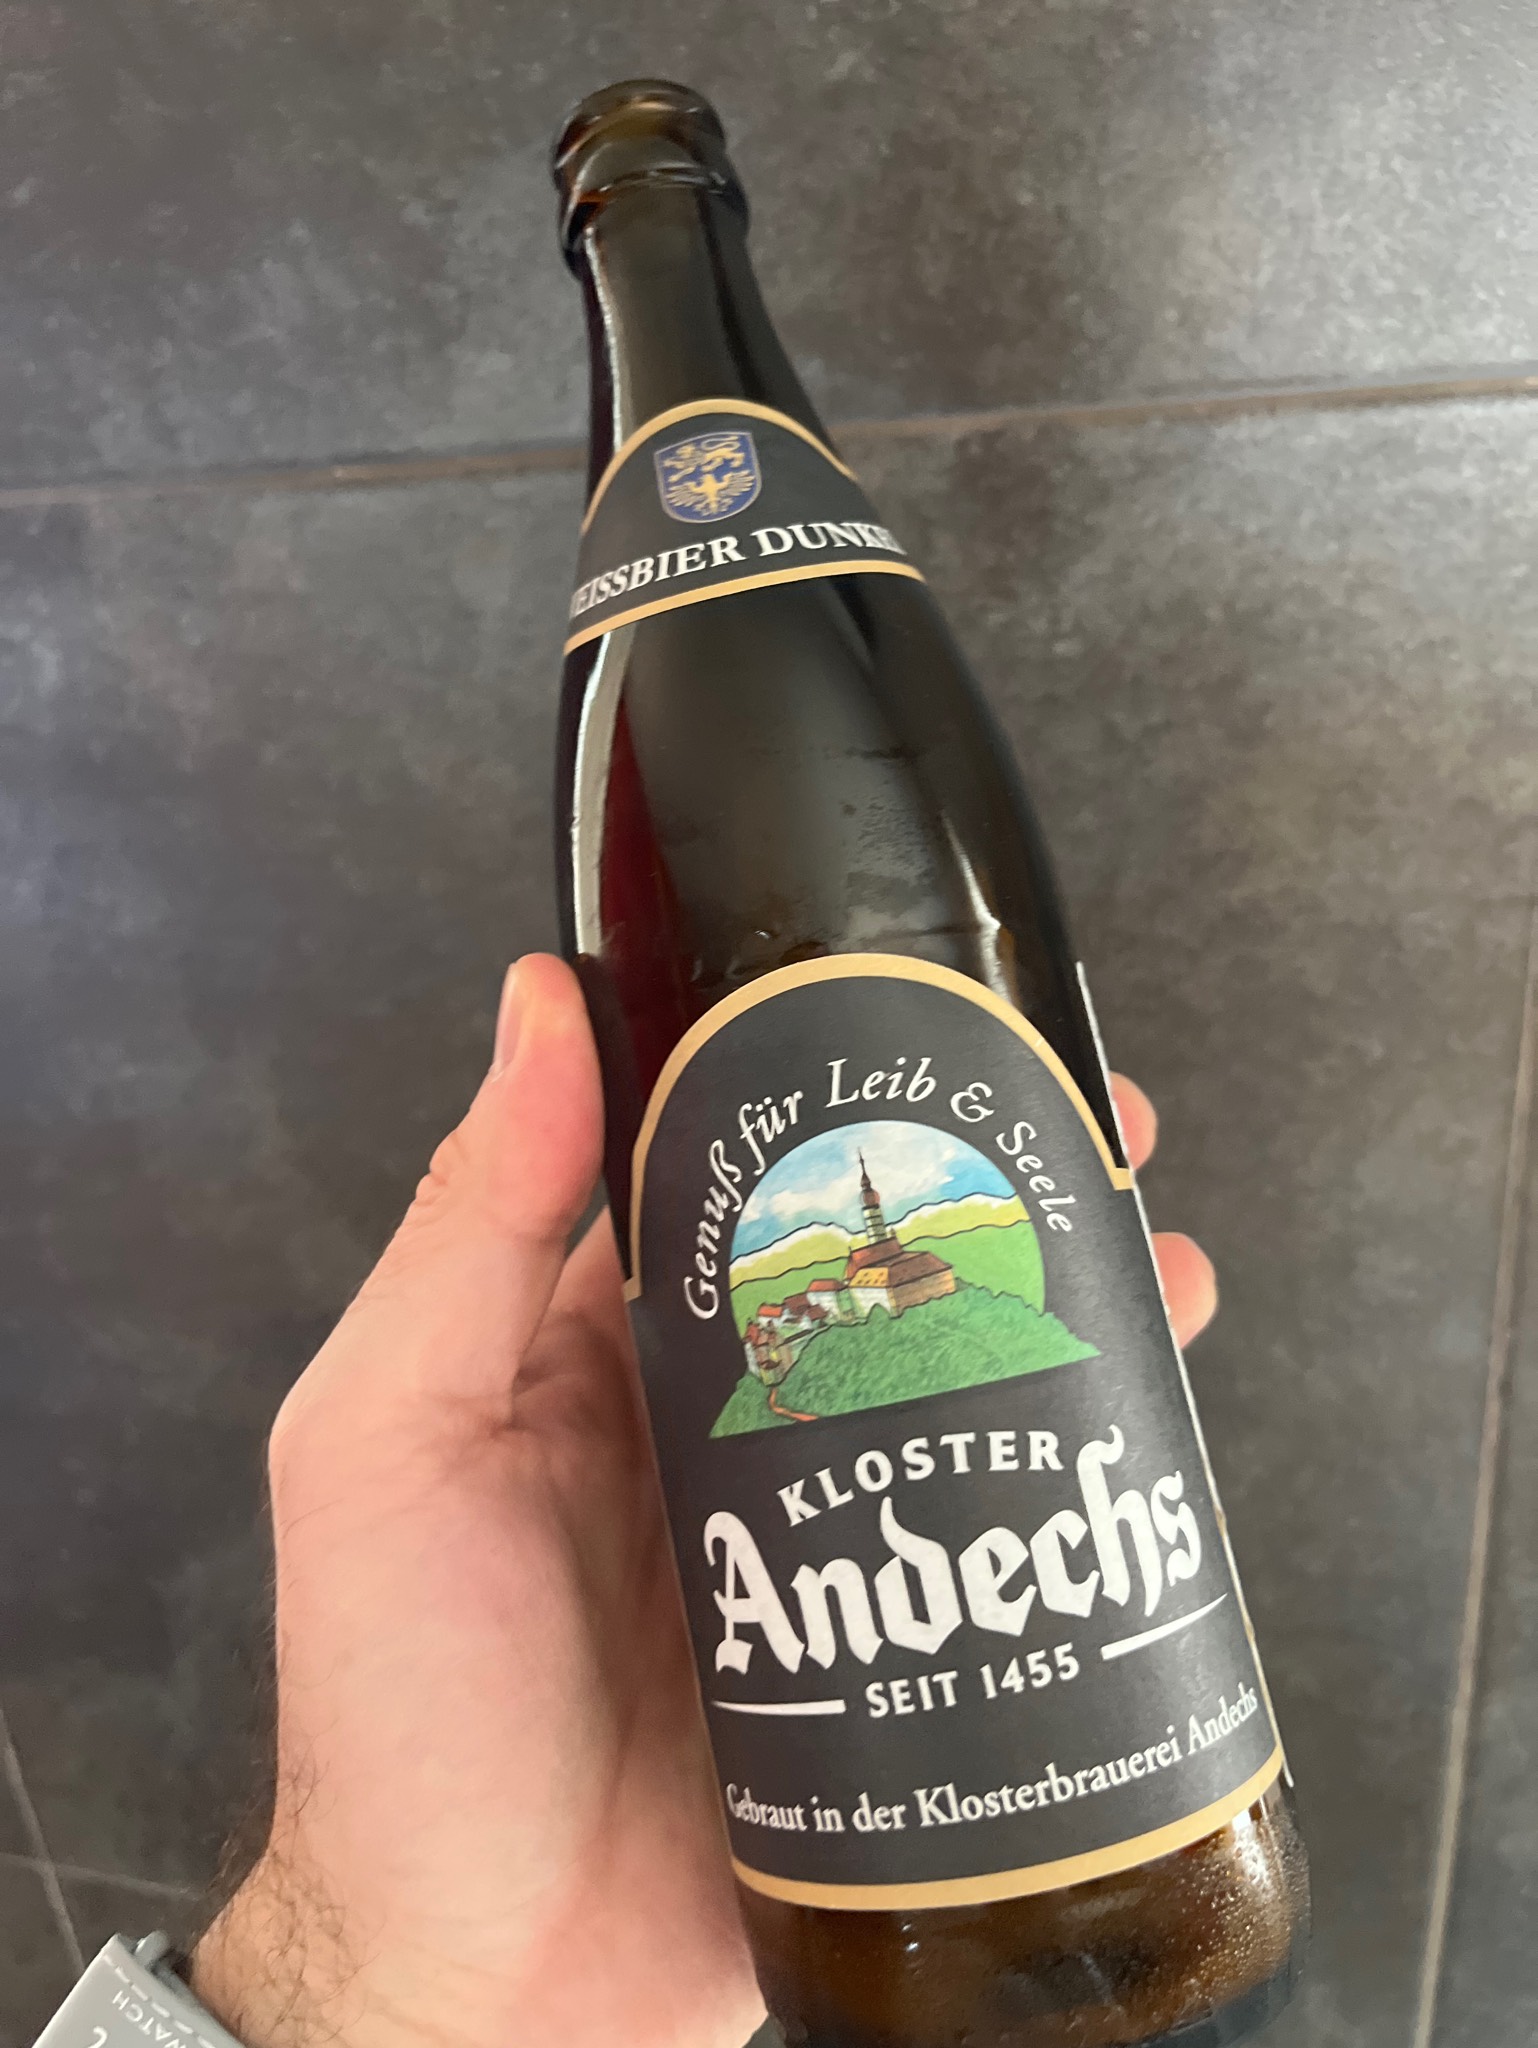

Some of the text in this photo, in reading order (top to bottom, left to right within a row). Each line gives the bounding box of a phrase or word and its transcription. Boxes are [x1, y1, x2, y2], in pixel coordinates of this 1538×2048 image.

[569, 535, 747, 619] EISSBIER
[683, 1056, 1078, 1320] Genuß für Leib & Seele
[776, 1429, 1064, 1527] KLOSTER
[703, 1423, 1201, 1674] Andechs
[865, 1643, 1081, 1718] SEIT 1455
[726, 1681, 1259, 1832] Gebraut in der Klosterbrauerei Andechs
